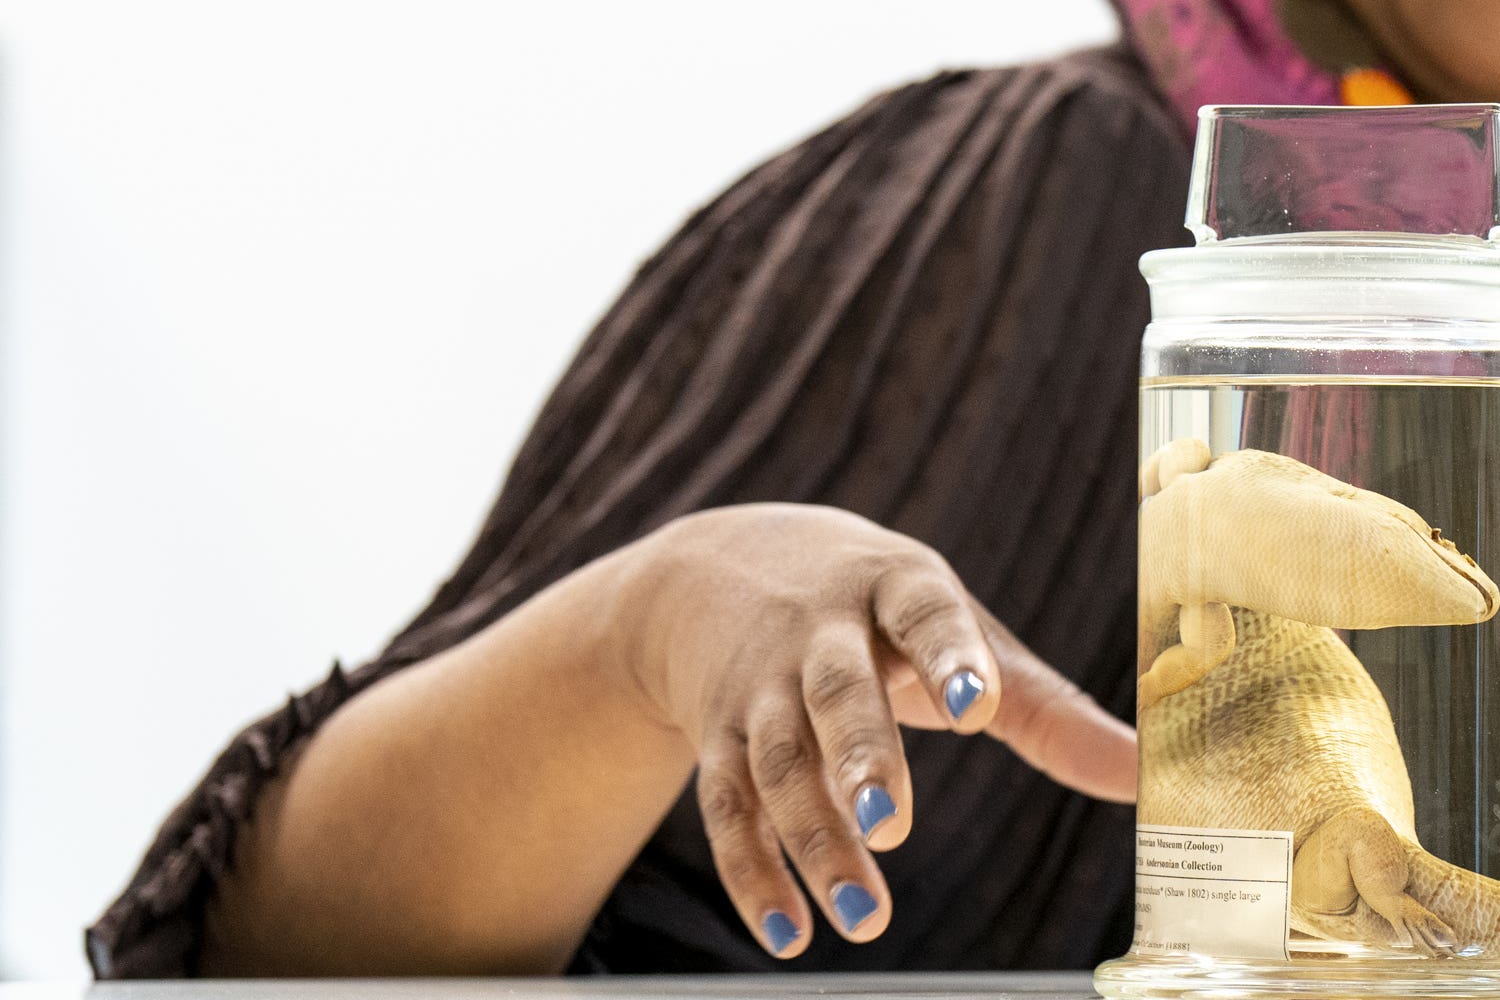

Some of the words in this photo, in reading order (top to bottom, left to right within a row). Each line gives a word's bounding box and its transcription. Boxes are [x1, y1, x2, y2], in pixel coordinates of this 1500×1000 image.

[1157, 839, 1182, 849] Museum
[1184, 840, 1224, 853] (Zoology)
[1181, 860, 1222, 872] Collection
[1164, 886, 1185, 899] (Shaw
[1187, 888, 1210, 900] 1802)
[1211, 890, 1236, 903] single
[1239, 891, 1262, 903] large
